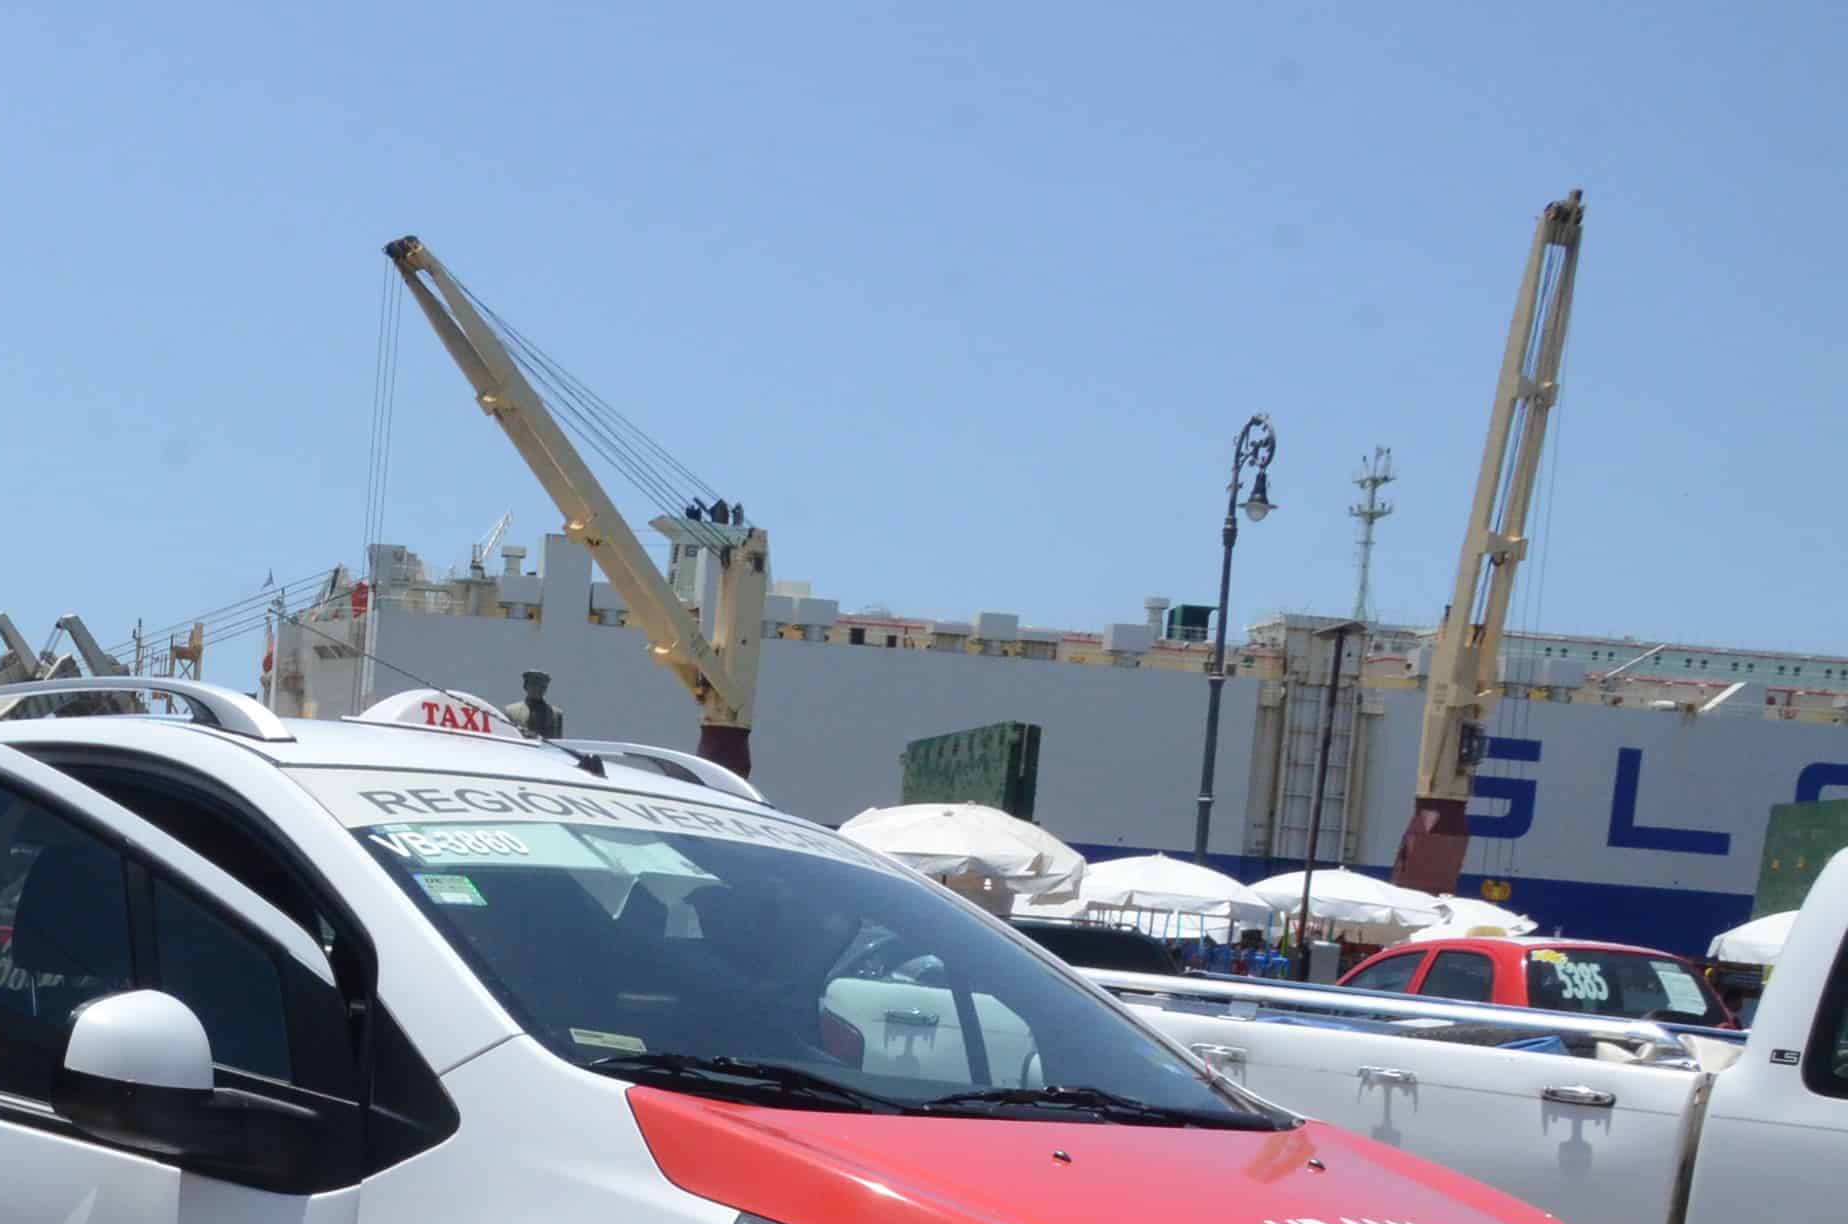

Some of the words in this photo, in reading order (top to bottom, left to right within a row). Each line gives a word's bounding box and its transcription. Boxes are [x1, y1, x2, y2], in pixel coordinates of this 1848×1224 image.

[421, 702, 491, 733] TAXI
[360, 787, 618, 821] REGIÓN
[368, 830, 530, 858] VB-3860
[1555, 962, 1609, 1001] 5385
[1772, 1051, 1799, 1063] LS
